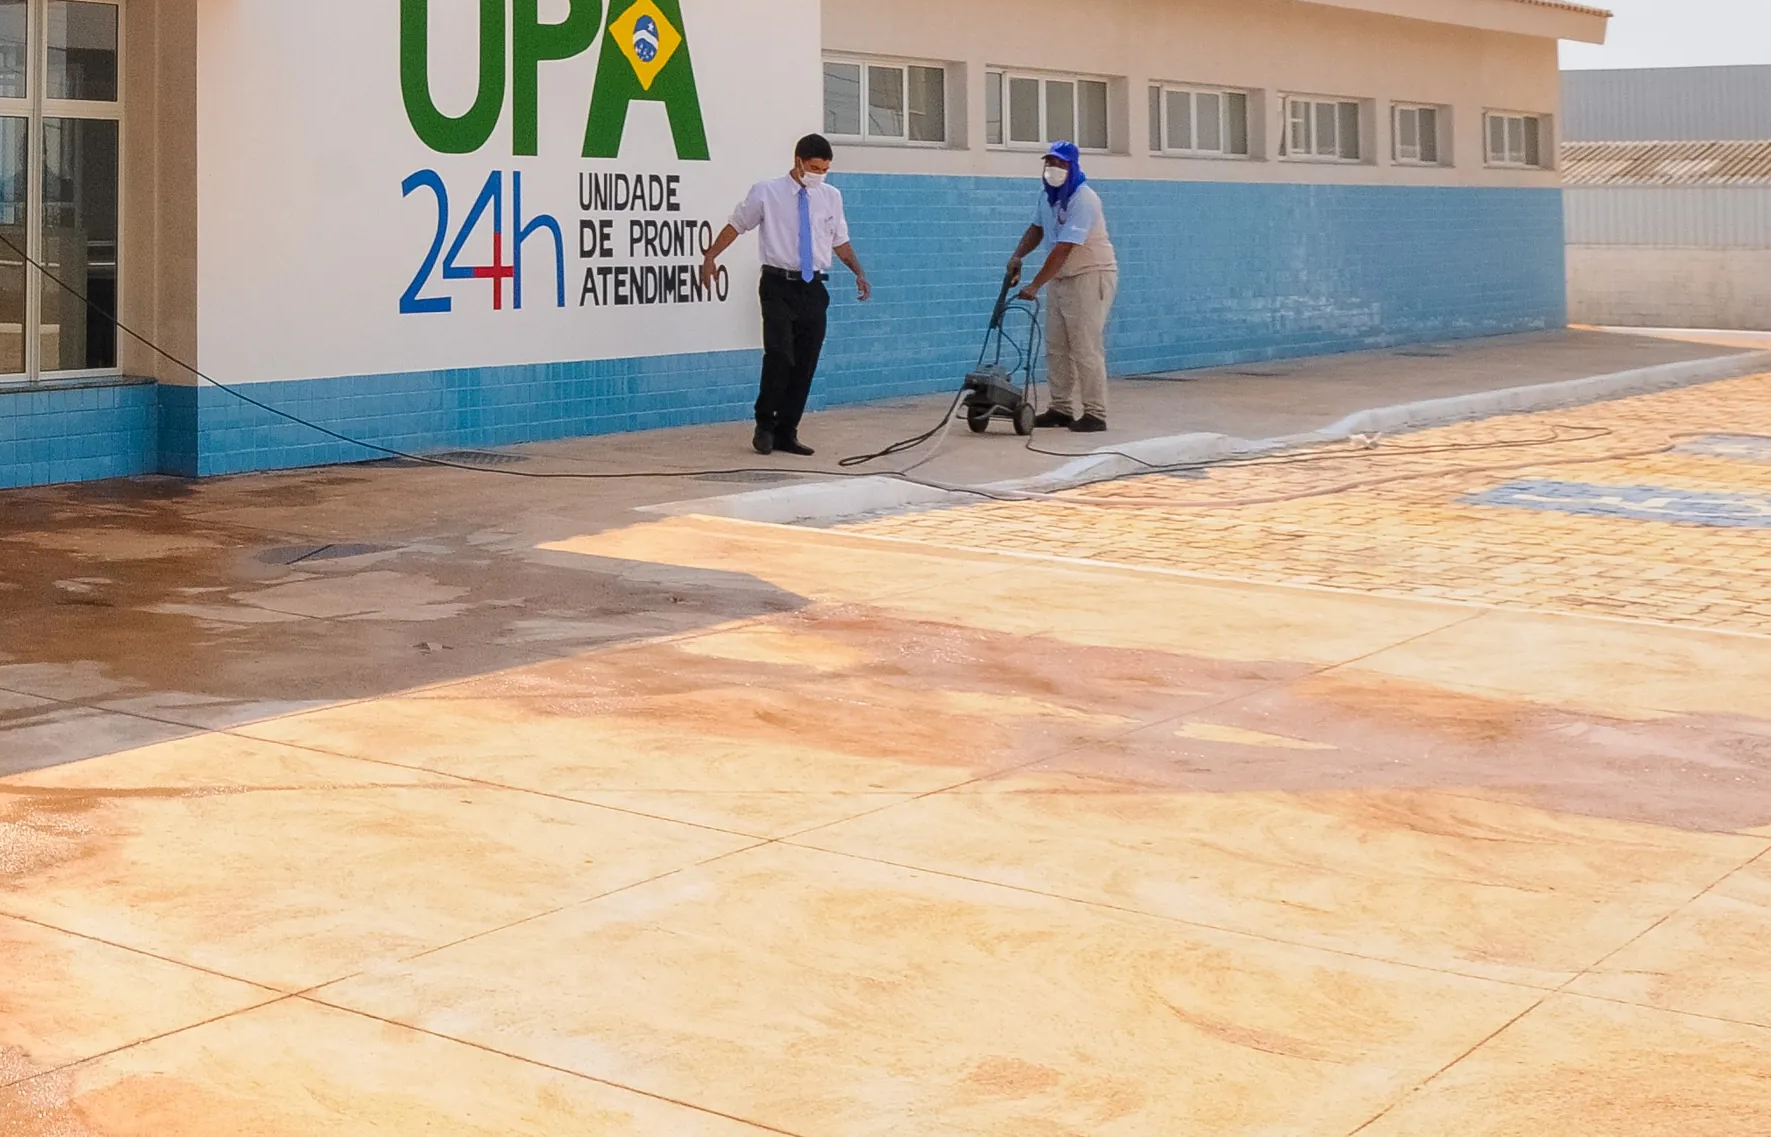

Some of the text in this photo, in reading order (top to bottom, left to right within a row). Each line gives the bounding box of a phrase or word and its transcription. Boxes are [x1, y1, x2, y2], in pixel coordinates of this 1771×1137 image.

[579, 172, 680, 211] UNIDADE
[399, 168, 566, 314] 24h
[579, 219, 713, 258] DE PRONTO
